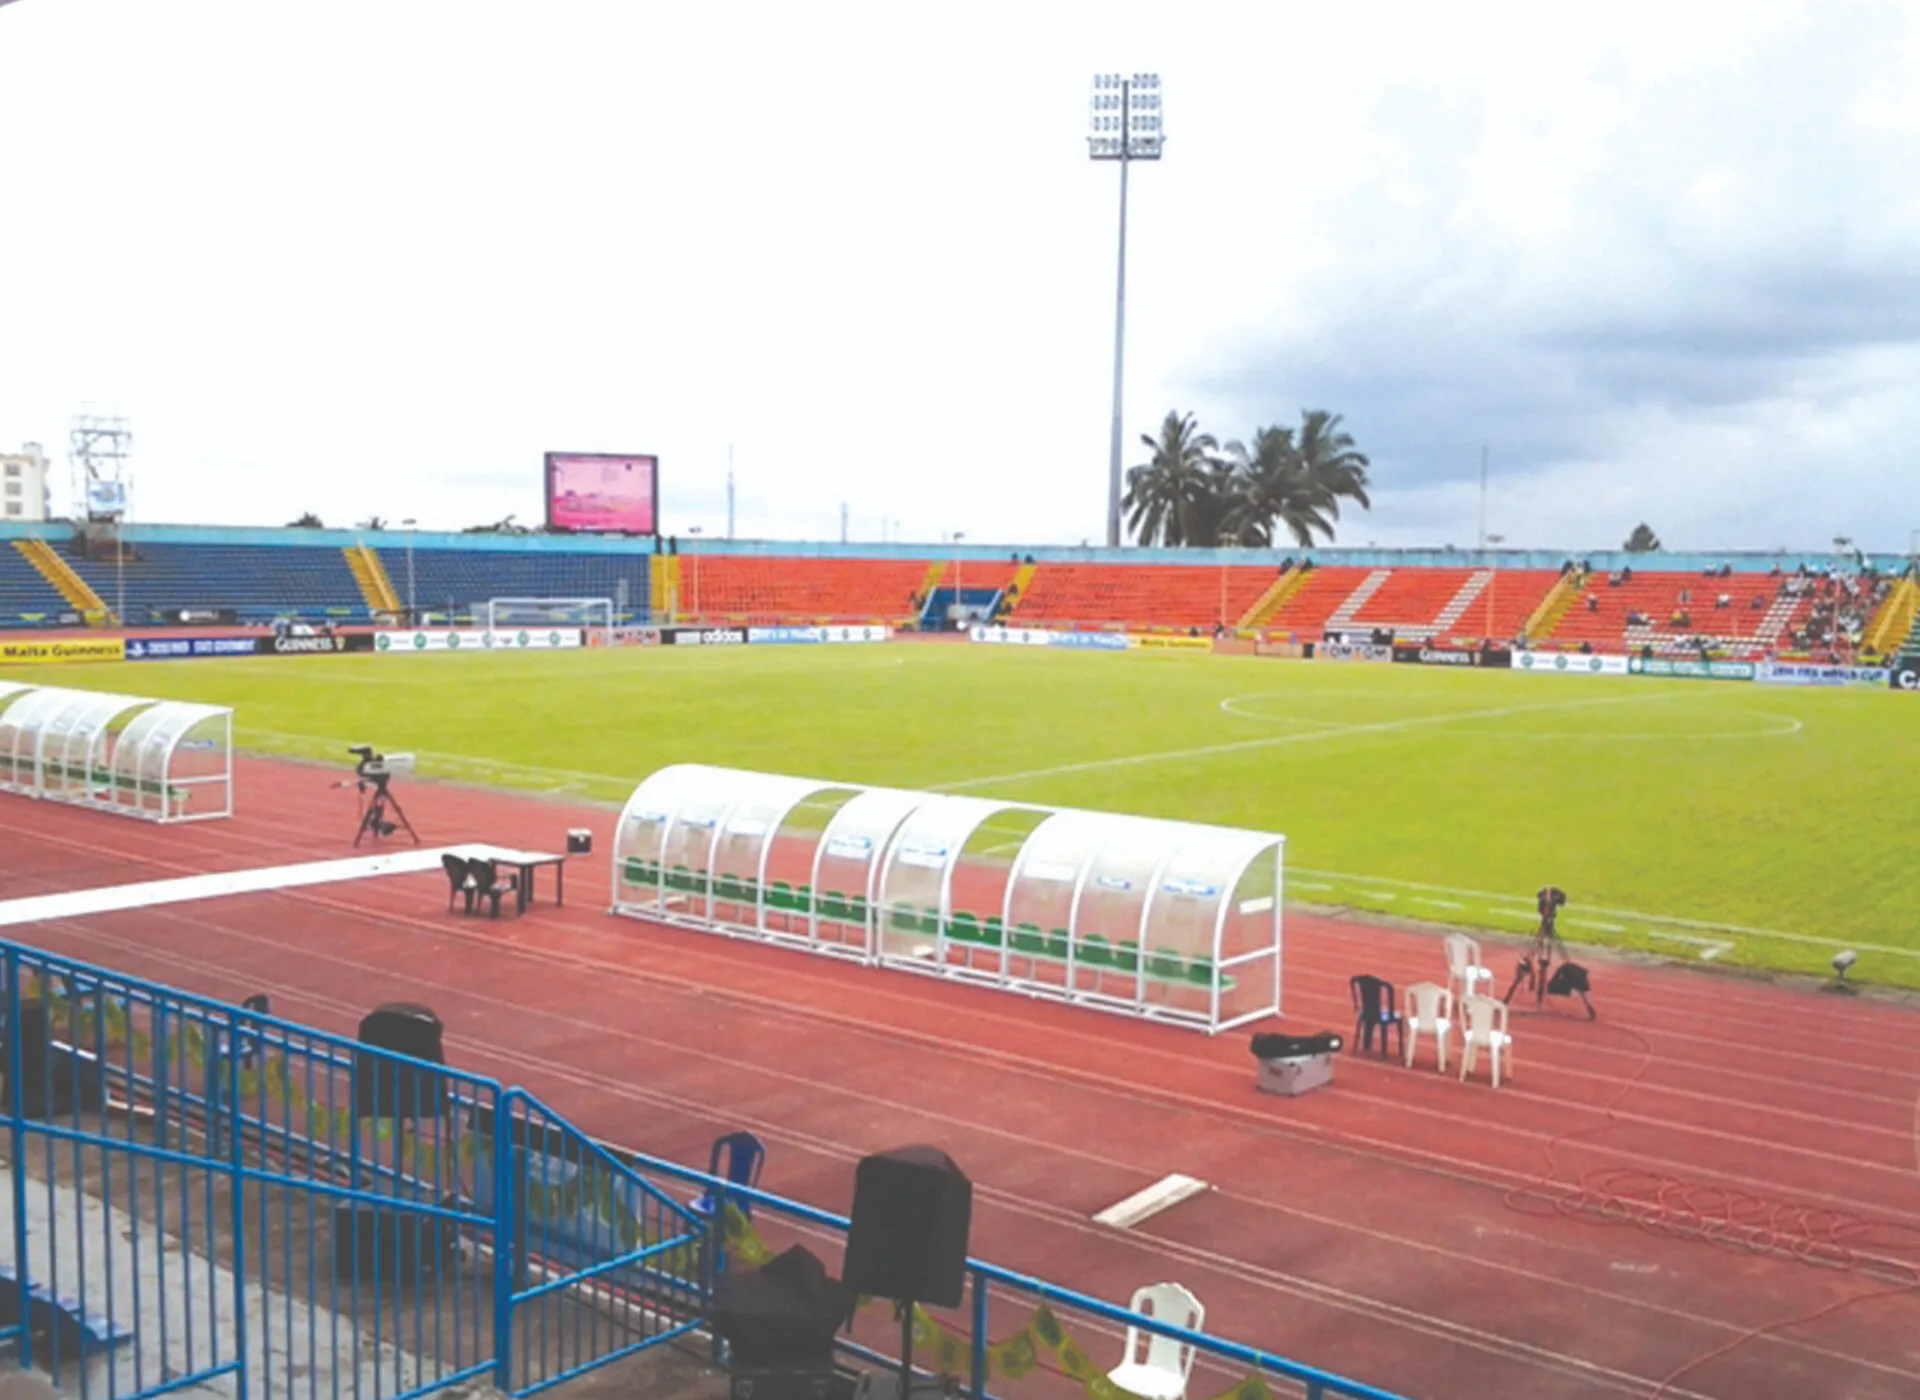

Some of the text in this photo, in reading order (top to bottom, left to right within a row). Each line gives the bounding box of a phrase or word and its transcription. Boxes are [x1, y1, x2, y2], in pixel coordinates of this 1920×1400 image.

[3, 645, 47, 657] Malta
[275, 637, 333, 652] GUINNESS
[1420, 648, 1470, 663] GUINNESS
[1861, 670, 1883, 681] CUP
